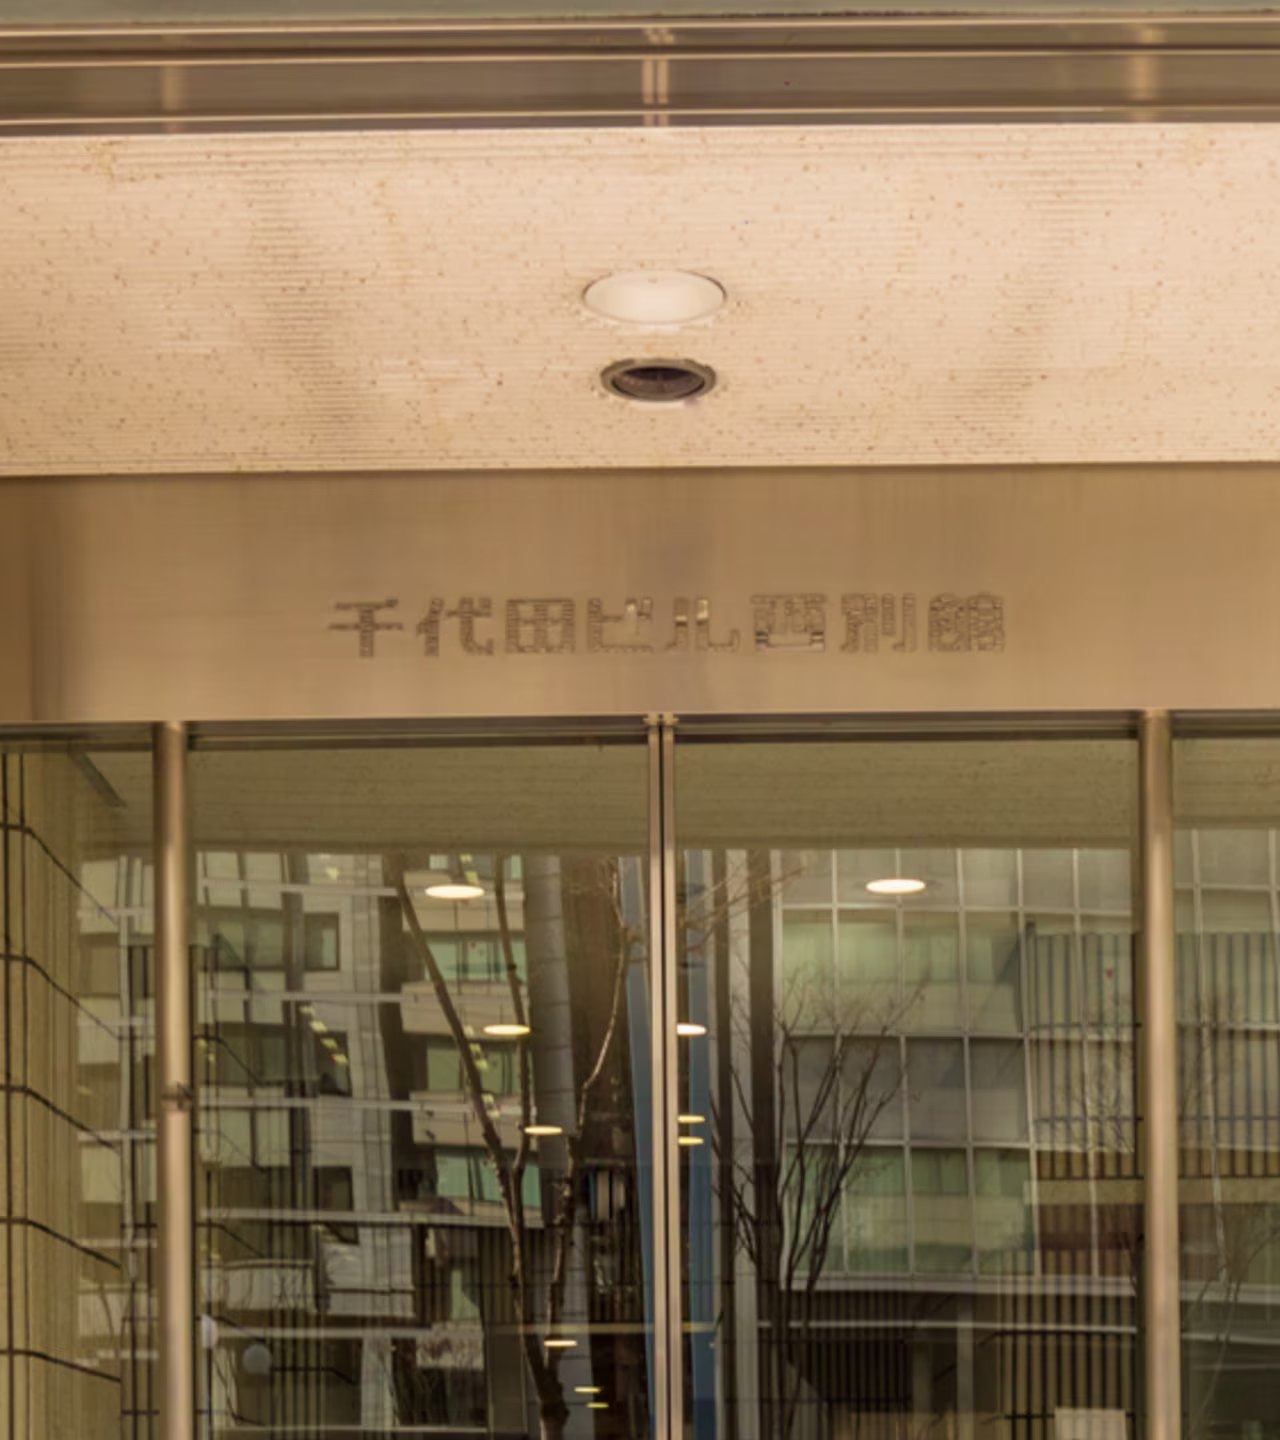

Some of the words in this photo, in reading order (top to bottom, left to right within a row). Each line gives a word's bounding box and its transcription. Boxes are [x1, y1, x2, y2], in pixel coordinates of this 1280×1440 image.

[327, 591, 1006, 658] 千代田ビル西別館
